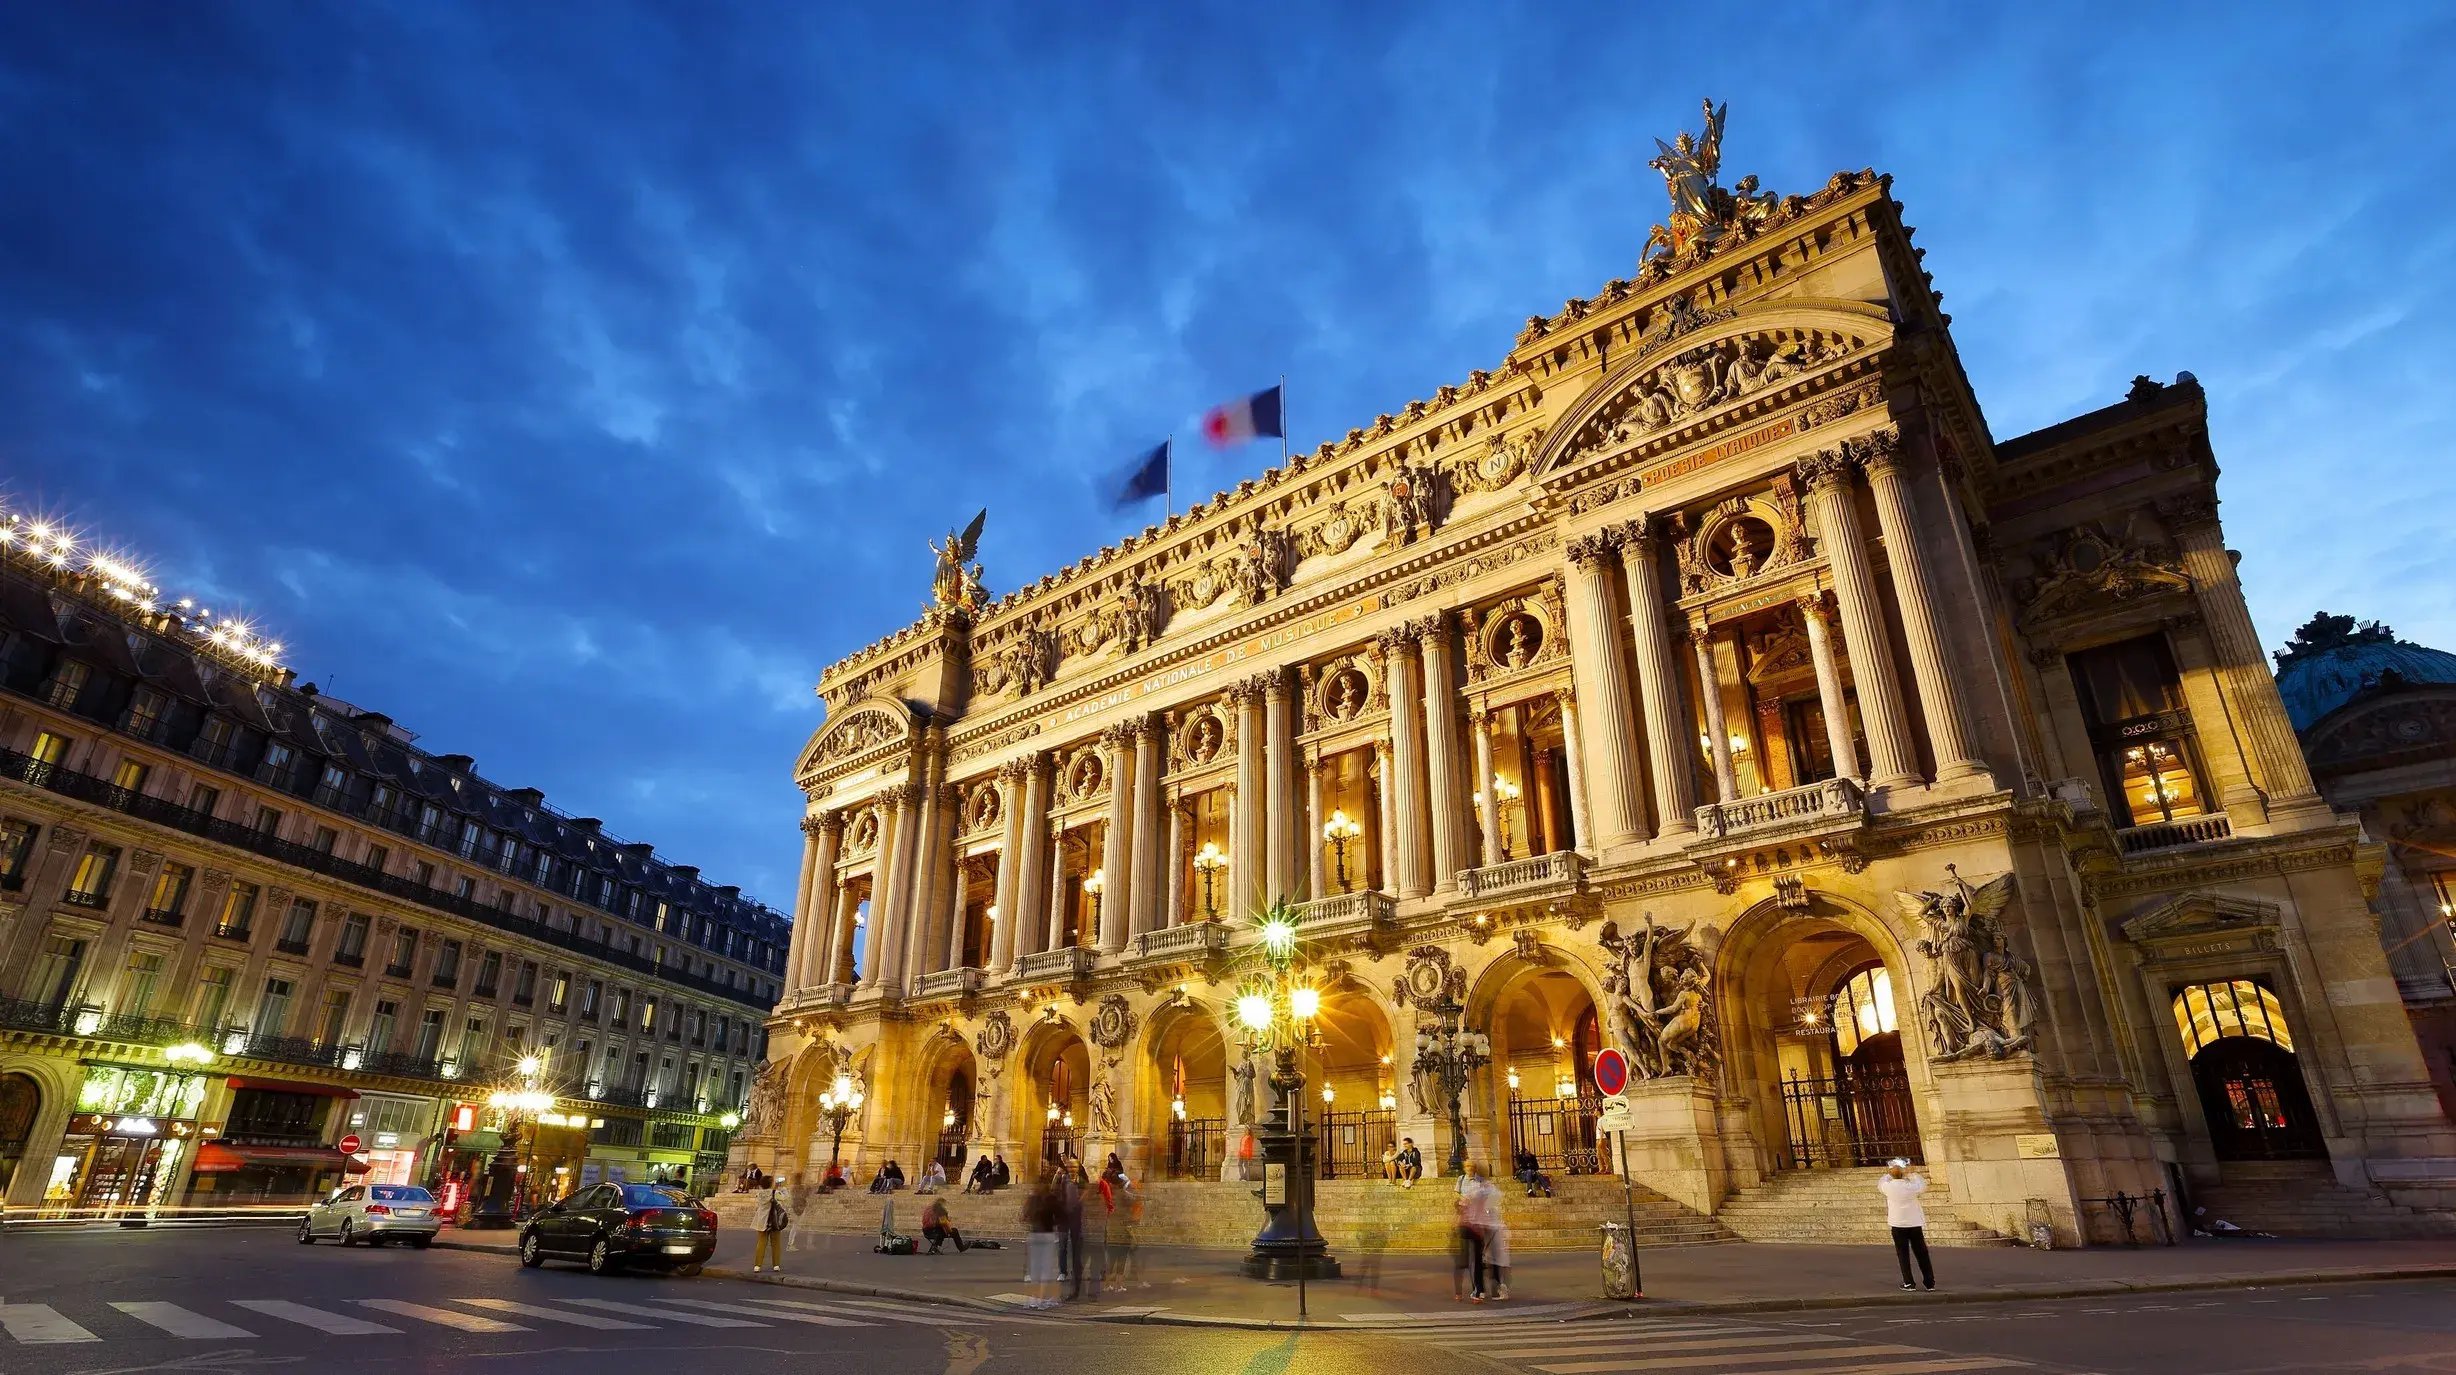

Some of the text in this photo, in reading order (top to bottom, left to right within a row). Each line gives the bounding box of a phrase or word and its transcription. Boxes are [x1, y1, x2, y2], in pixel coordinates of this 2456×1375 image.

[1490, 457, 1501, 471] N
[1650, 452, 1706, 484] POESIE
[1332, 524, 1343, 536] N
[1199, 580, 1208, 592] N
[1065, 613, 1338, 722] ACADEMIE NATIONALE DE MUSIQUE
[2184, 942, 2231, 955] BILLETS
[1790, 991, 1870, 1005] LIBRAIRIE BOUTQUE
[1792, 1003, 1832, 1014] BOOOP
[1793, 1012, 1829, 1023] LIBRIA
